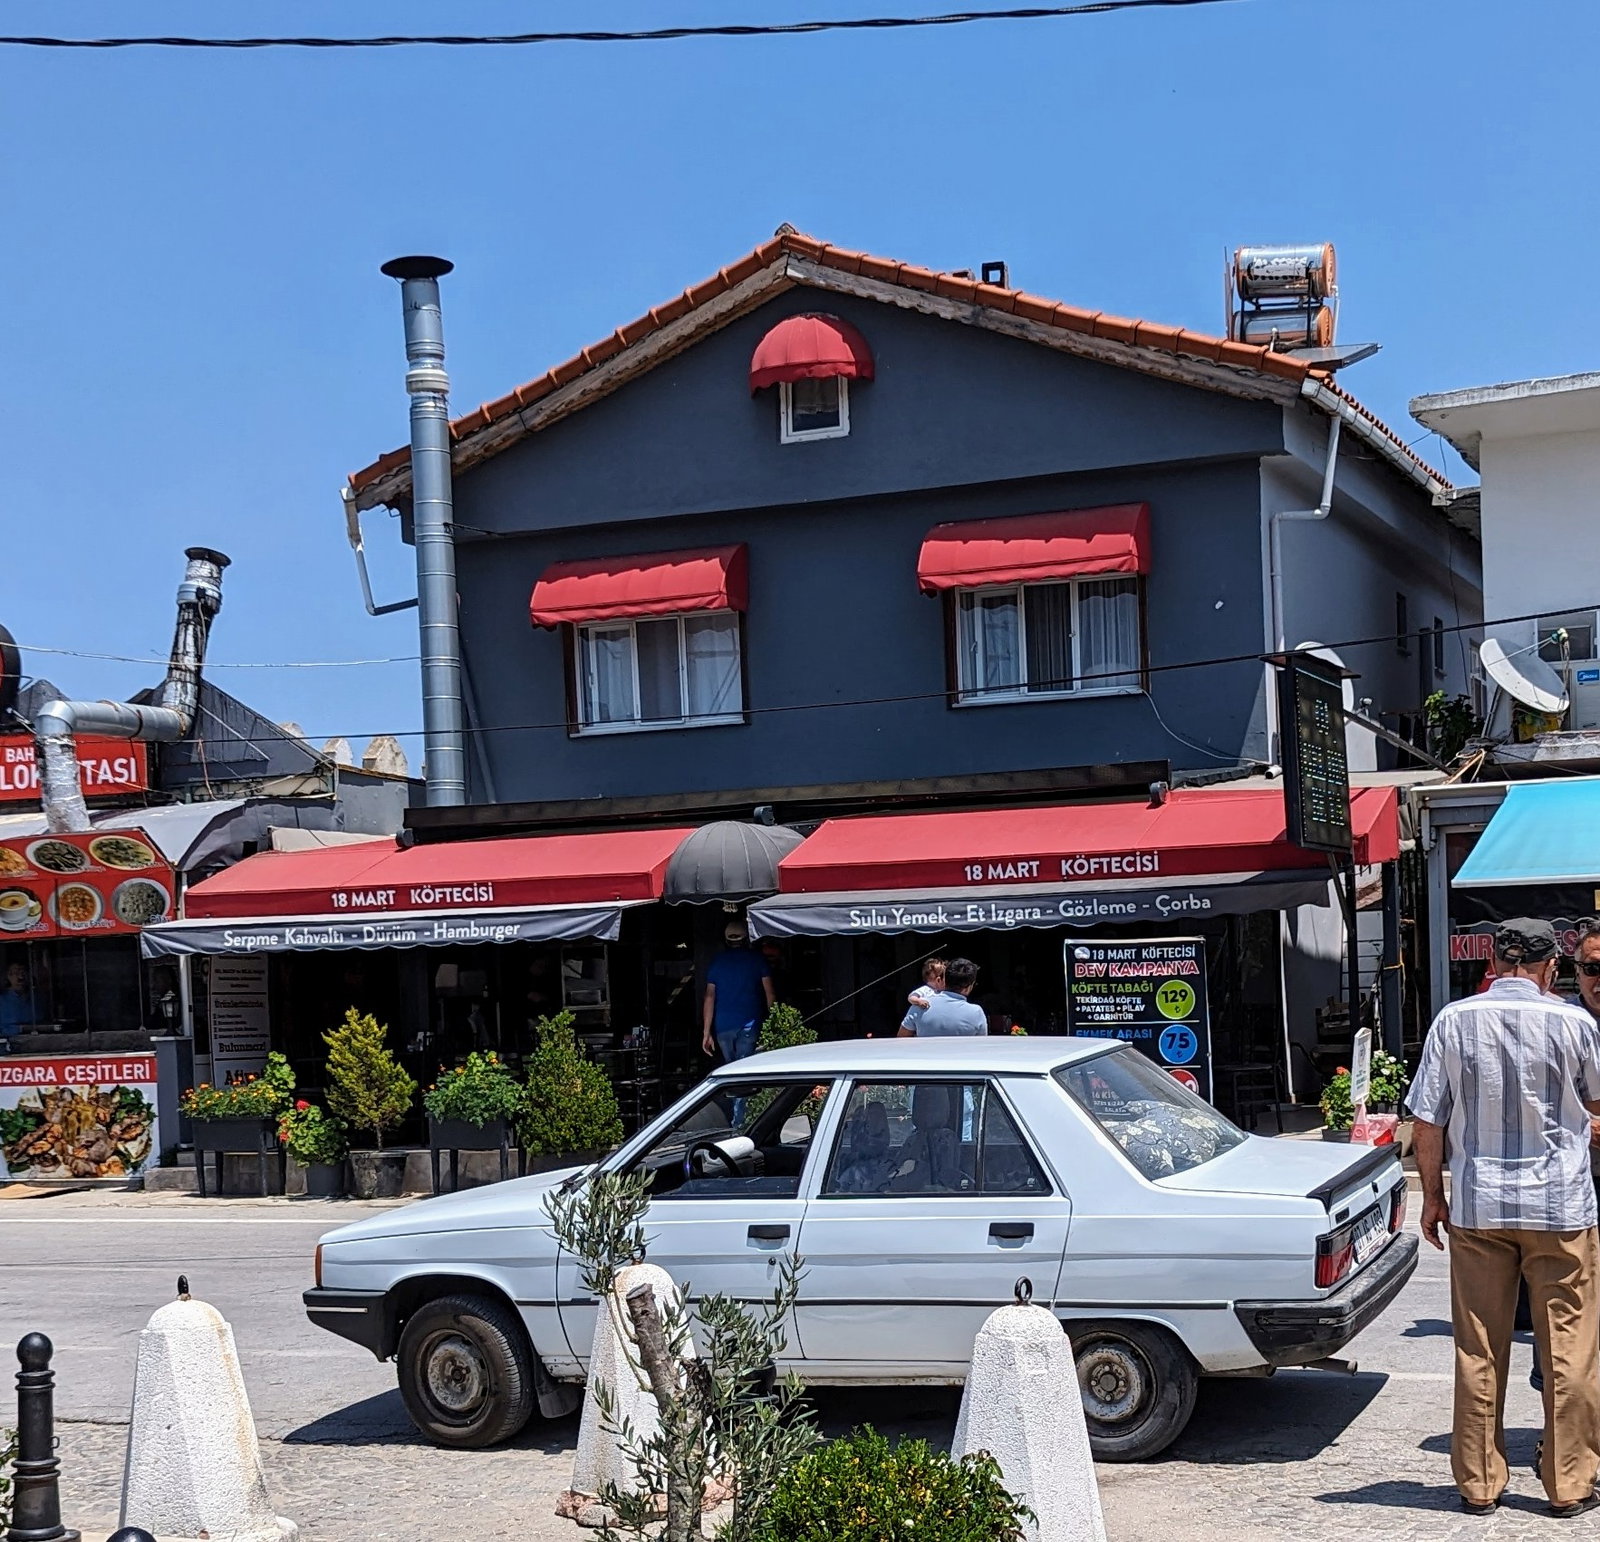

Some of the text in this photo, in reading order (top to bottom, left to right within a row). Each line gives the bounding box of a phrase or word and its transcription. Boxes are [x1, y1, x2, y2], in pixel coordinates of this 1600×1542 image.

[5, 747, 35, 763] BAH
[0, 756, 138, 791] LOKTASI
[964, 850, 1160, 882] 18 MART KÖFTECİSİ
[331, 882, 494, 908] 18 MART KÖFTECİSİ
[849, 909, 888, 929] Sulu
[891, 906, 949, 928] Yemek
[966, 904, 986, 923] Et
[991, 903, 1042, 928] Izgara
[1058, 898, 1137, 918] Gözleme
[1155, 893, 1211, 918] Çorba
[224, 931, 279, 950] Serpme
[284, 928, 344, 945] Kahvaltı
[363, 925, 417, 944] Dürüm
[433, 921, 521, 941] Hamburger
[1092, 944, 1195, 960] 18 MART KÖFTECİSİ
[1075, 960, 1200, 978] DEV KAMPANYA
[1071, 980, 1153, 994] KÖFTE TABAĞI
[1075, 994, 1142, 1004] TEKİRDAĞ KÖFTE
[1161, 989, 1188, 1004] 129
[1081, 1004, 1115, 1012] PATATES
[1122, 1002, 1146, 1012] PİLAV
[1093, 1011, 1134, 1021] GARNİTÜR
[1075, 1028, 1152, 1039] EKMEK ARASI
[1165, 1032, 1190, 1050] 75
[64, 1060, 150, 1084] ÇEŞİTLERİ
